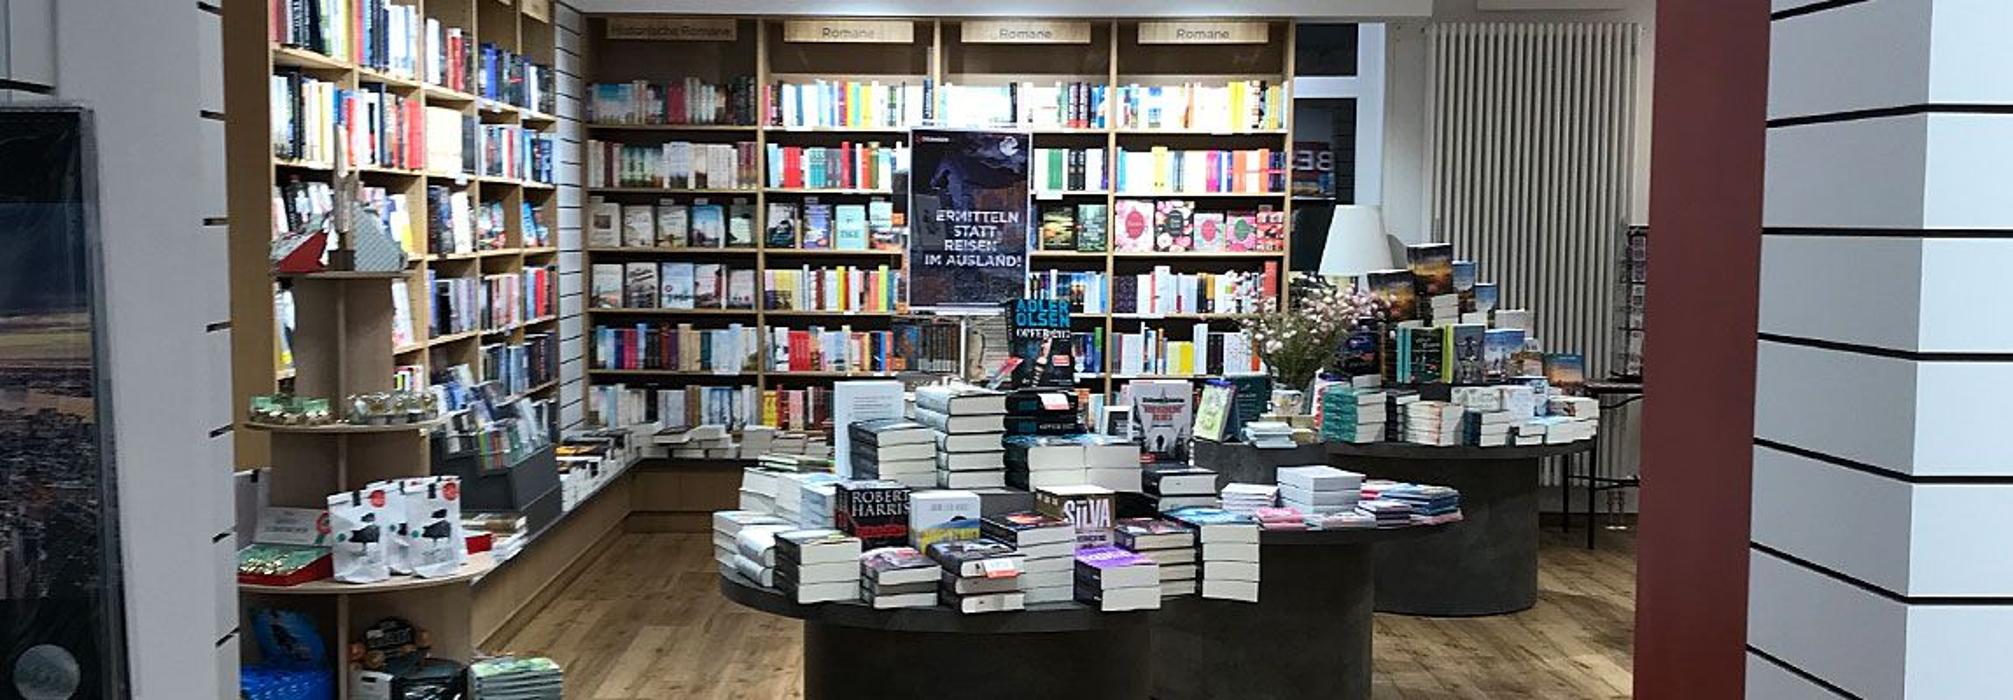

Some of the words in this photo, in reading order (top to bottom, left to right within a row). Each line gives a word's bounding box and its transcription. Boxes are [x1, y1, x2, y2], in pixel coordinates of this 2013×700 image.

[822, 27, 876, 38] Romane
[999, 28, 1053, 40] Romane
[1176, 28, 1230, 40] Romane
[935, 209, 1020, 224] ERMITTELN
[953, 224, 998, 238] STATT
[944, 238, 998, 252] REISEN
[924, 254, 942, 266] IM
[946, 254, 1022, 268] AUSLAND!
[1016, 299, 1070, 313] ADLER
[1016, 312, 1070, 328] OLSEN
[851, 489, 911, 504] ROBERT
[851, 502, 912, 517] HARRIS
[1063, 498, 1112, 528] SILVA
